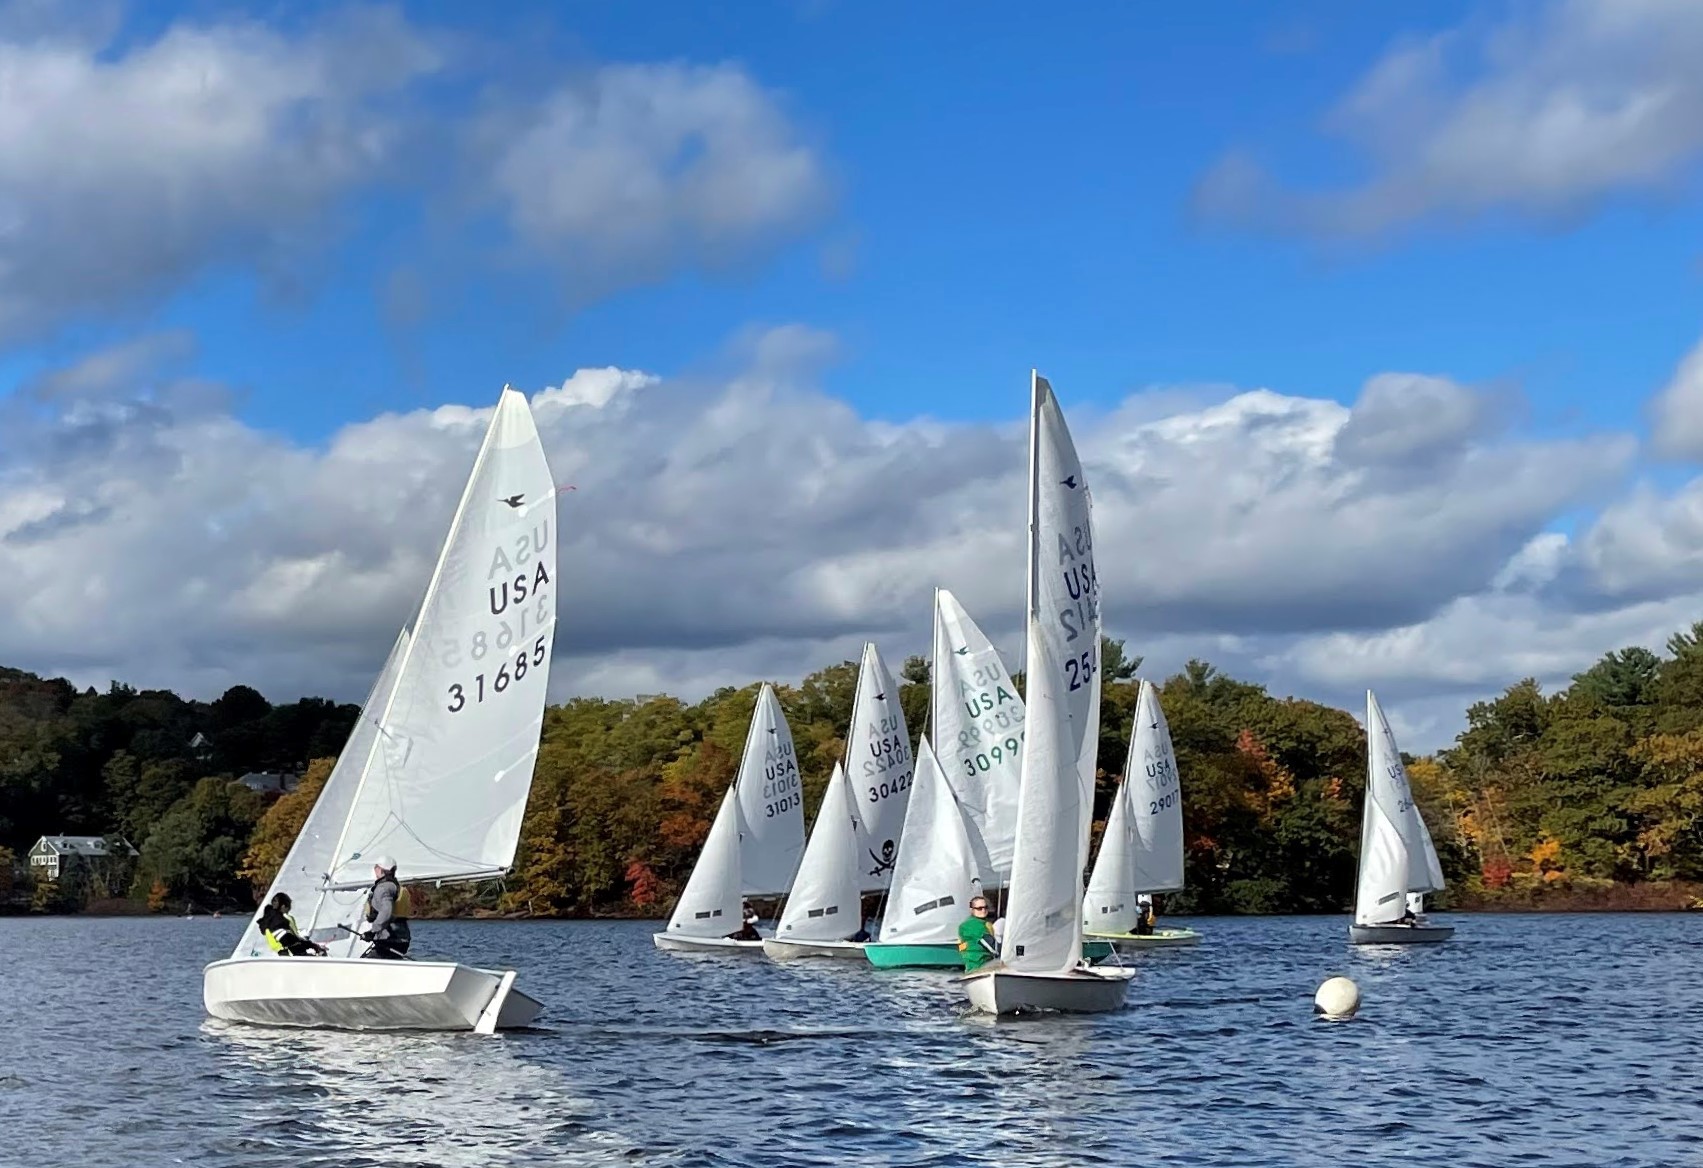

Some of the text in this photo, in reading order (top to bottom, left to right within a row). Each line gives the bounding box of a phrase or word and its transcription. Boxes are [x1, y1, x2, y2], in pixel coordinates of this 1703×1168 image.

[489, 561, 550, 615] USA
[447, 635, 545, 713] 31685
[965, 686, 1014, 719] USA
[869, 734, 901, 758] USA
[765, 759, 796, 780] USA
[1146, 758, 1170, 778] USA
[868, 770, 913, 803] 30422
[765, 792, 800, 818] 31013
[1149, 788, 1179, 816] 29017
